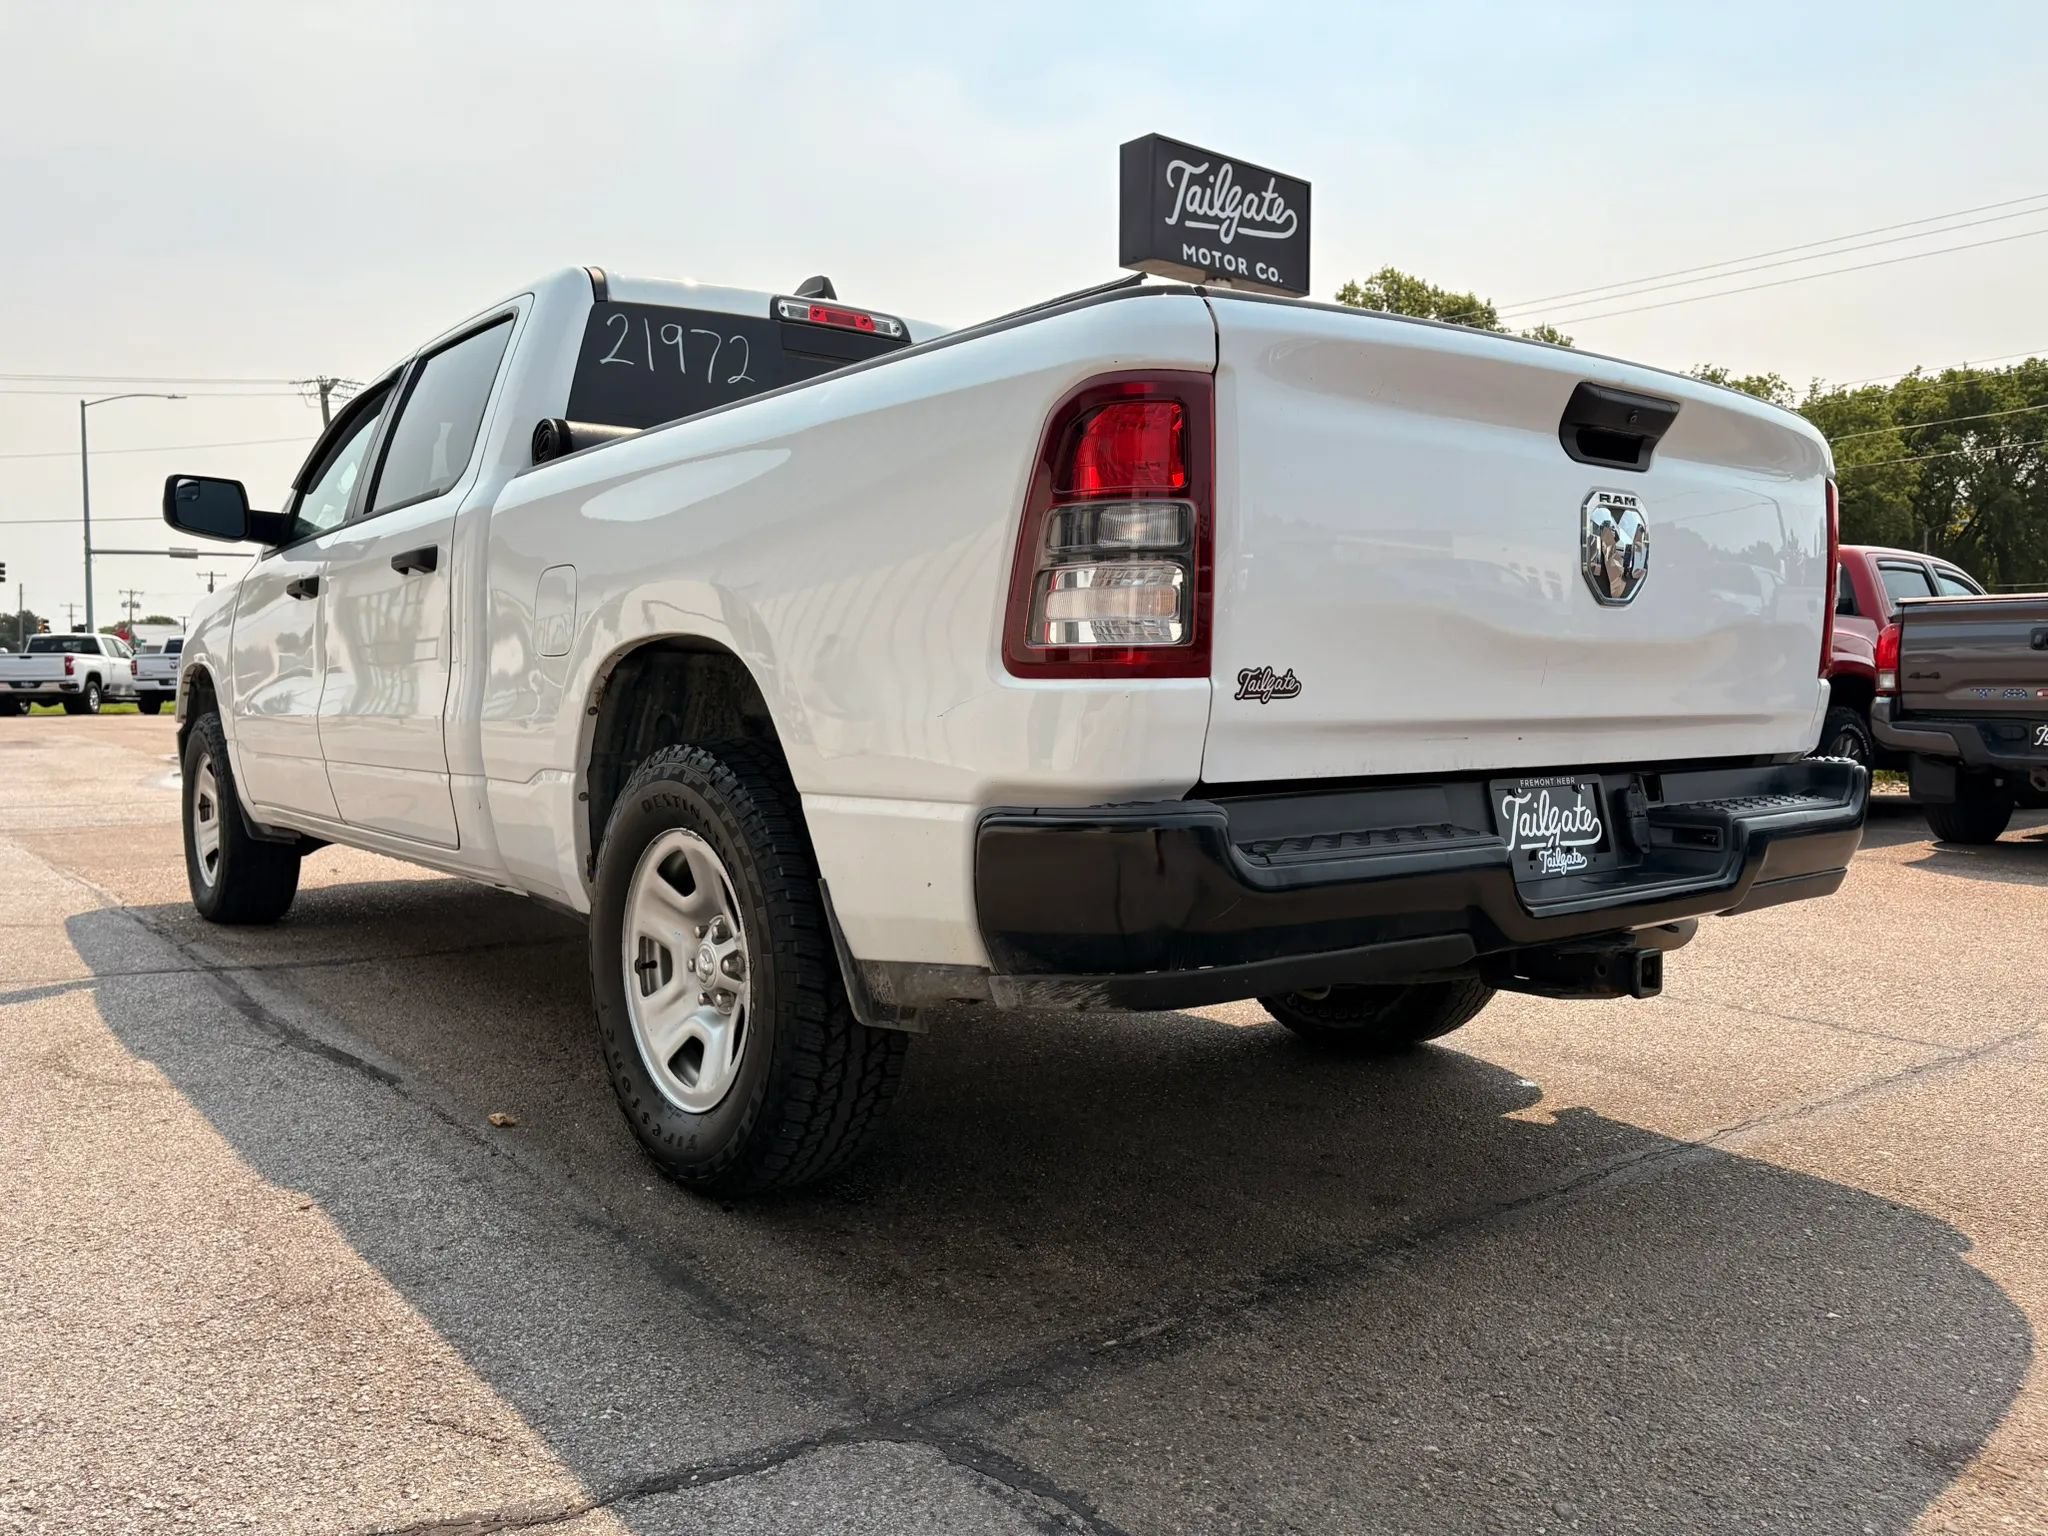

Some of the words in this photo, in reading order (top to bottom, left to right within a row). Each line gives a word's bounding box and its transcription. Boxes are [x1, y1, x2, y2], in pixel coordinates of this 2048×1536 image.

[1165, 159, 1298, 244] Tailgate
[1182, 243, 1249, 276] MOTOR
[600, 313, 756, 384] 21972
[1599, 493, 1638, 507] RAM
[1235, 666, 1302, 704] Tailgate
[1520, 777, 1554, 787] FREMONT
[1556, 776, 1576, 786] NEBR
[1502, 789, 1602, 851] Tailgate
[1538, 848, 1588, 875] Tailgate
